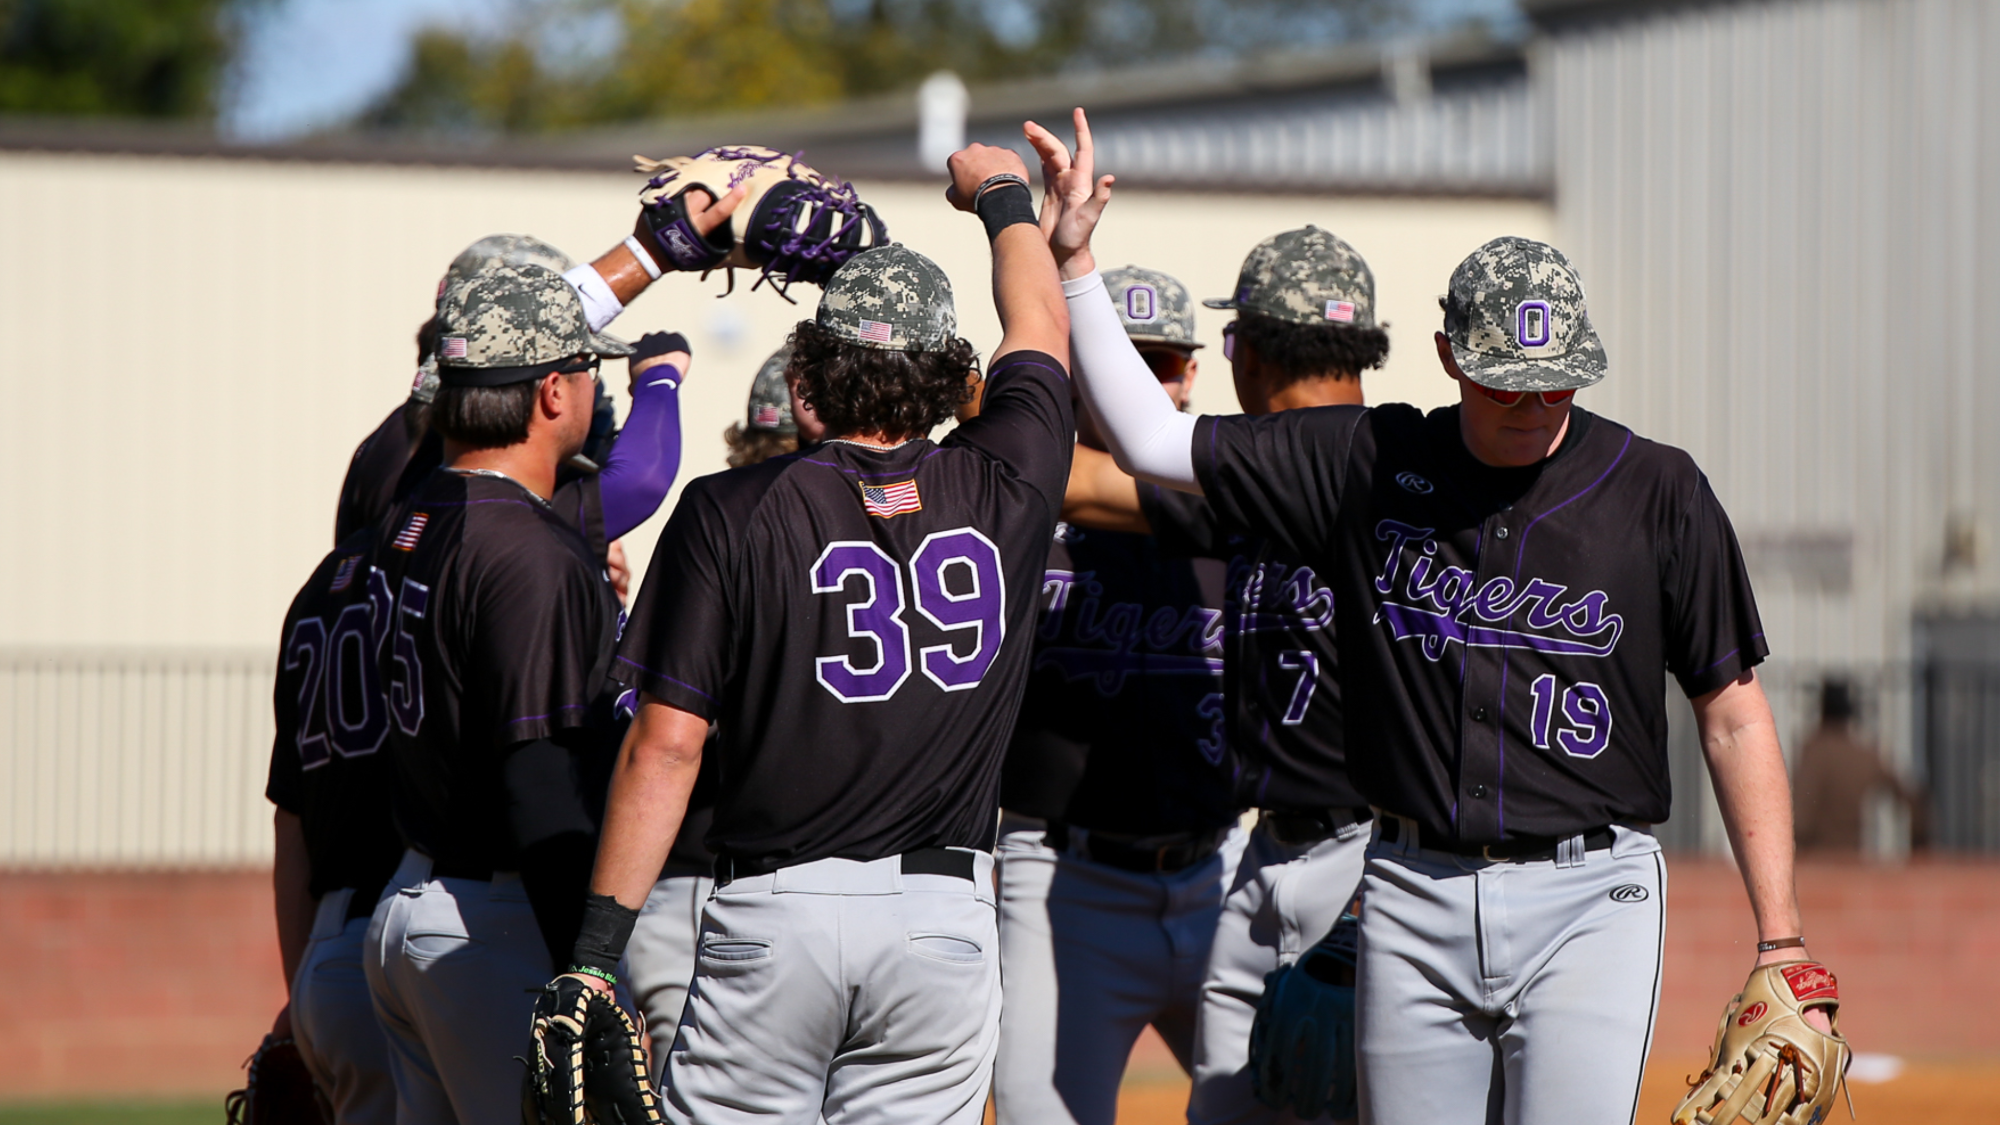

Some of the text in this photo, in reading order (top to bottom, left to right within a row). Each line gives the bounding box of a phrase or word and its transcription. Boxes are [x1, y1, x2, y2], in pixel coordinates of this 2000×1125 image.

[1123, 284, 1157, 324] O
[1515, 300, 1551, 349] O
[809, 526, 1006, 703] 39
[1034, 569, 1225, 698] Tiger
[1374, 518, 1623, 661] Tigers
[284, 603, 390, 772] 20
[1278, 650, 1319, 726] 7
[1530, 673, 1613, 759] 19
